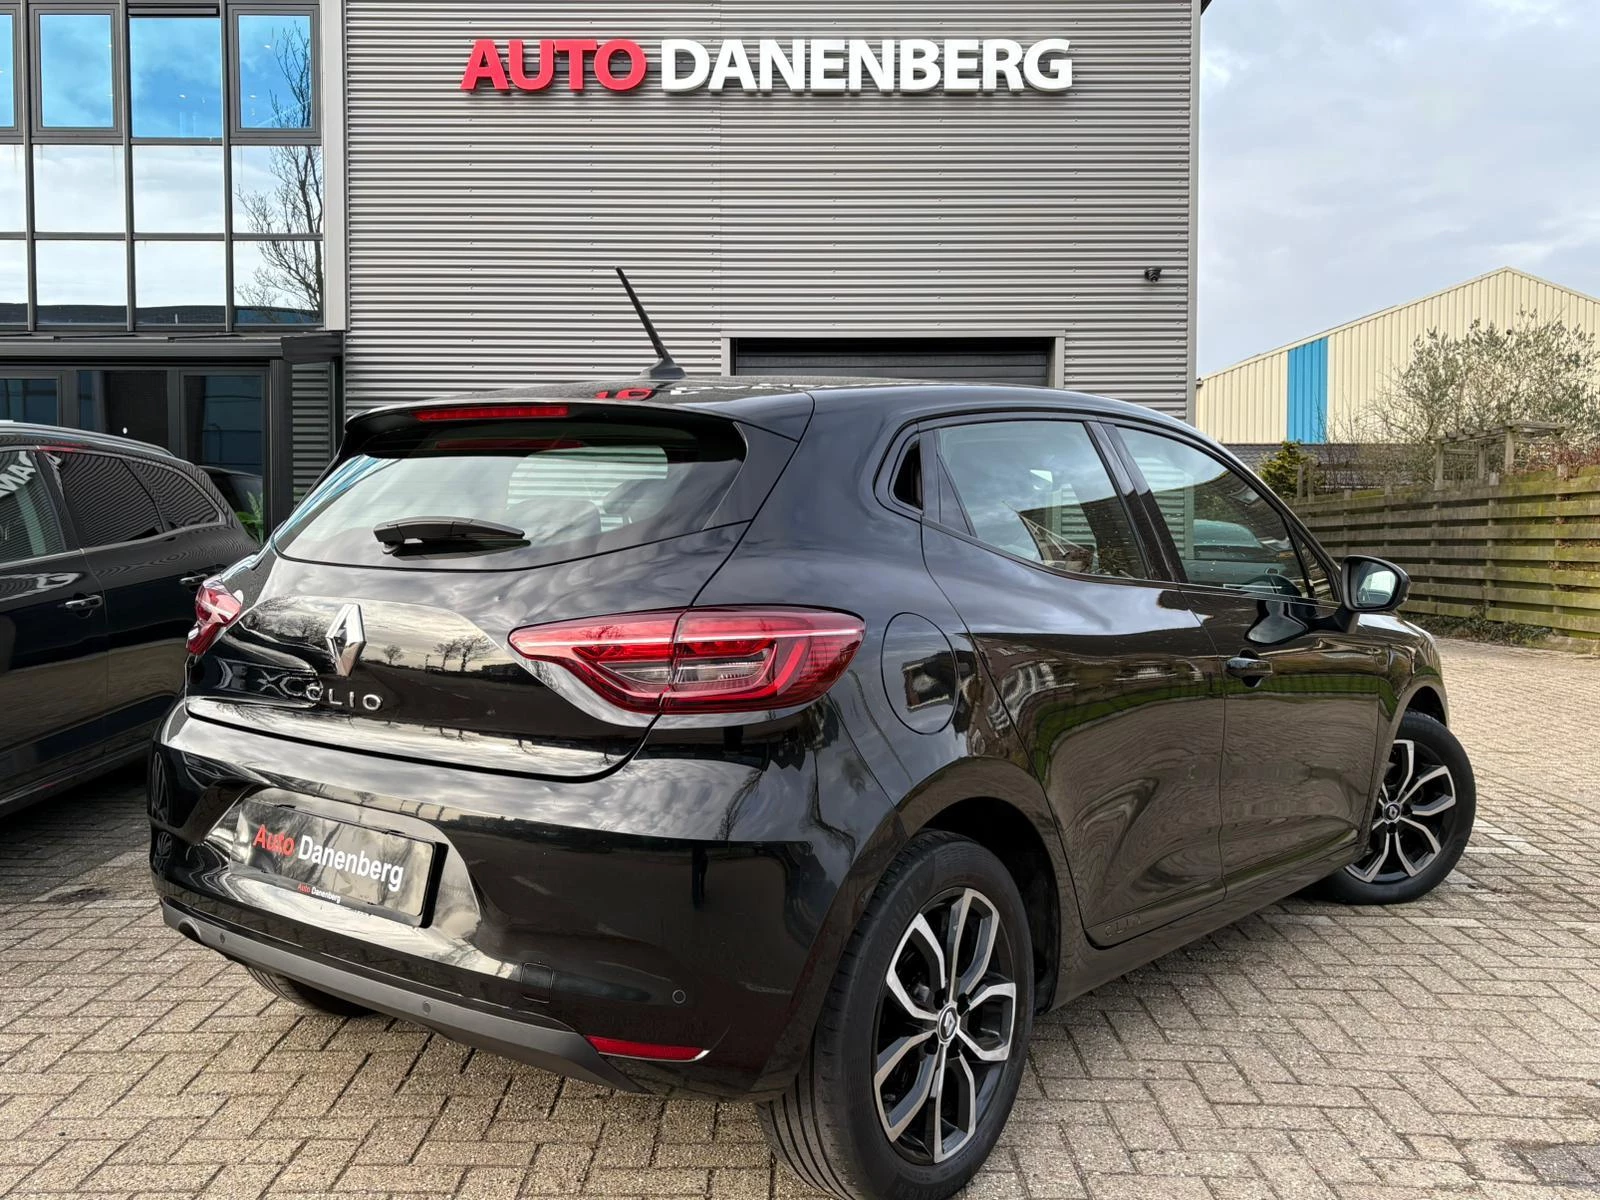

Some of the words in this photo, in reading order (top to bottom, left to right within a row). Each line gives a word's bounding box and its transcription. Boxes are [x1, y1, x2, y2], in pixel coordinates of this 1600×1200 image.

[460, 38, 647, 94] AUTO
[660, 37, 1073, 94] DANENBERG
[306, 685, 383, 711] CLIO
[253, 824, 295, 856] Auto
[297, 834, 404, 892] Danenberg
[297, 883, 311, 893] Auto
[311, 886, 342, 904] Danenberg
